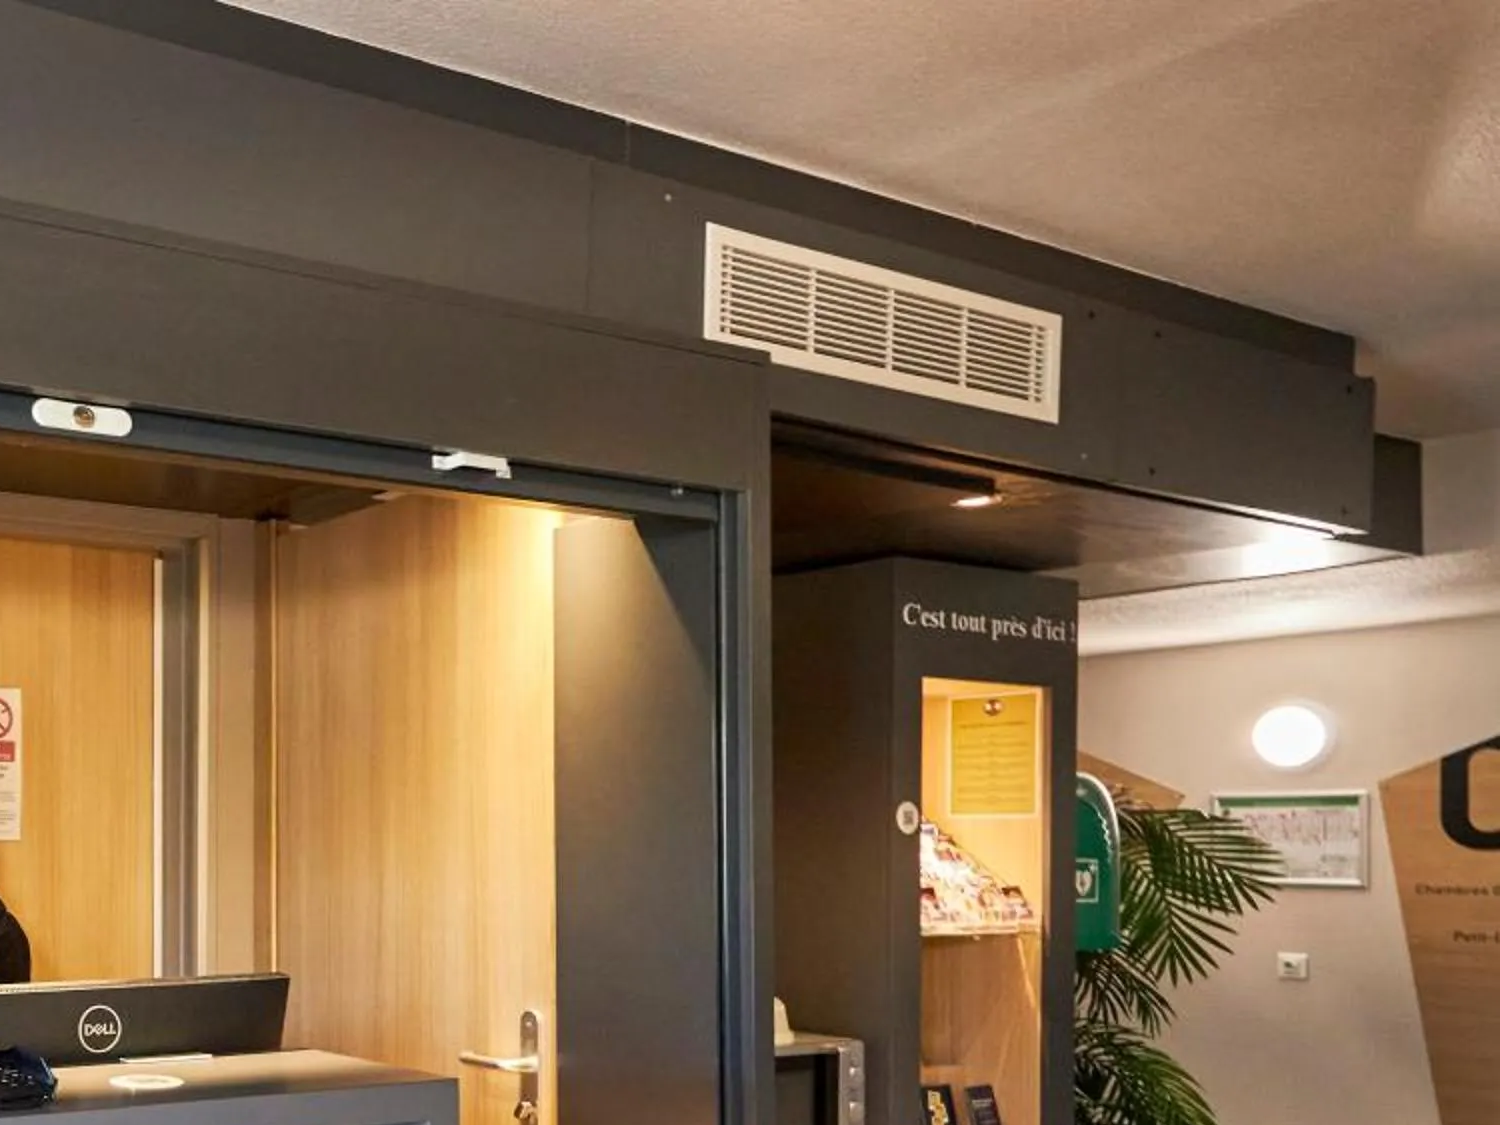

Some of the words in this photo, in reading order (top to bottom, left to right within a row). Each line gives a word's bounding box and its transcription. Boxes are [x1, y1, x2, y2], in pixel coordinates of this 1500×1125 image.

[902, 602, 946, 630] C'est
[951, 612, 987, 634] tout
[991, 615, 1028, 641] près
[1031, 616, 1066, 642] d'ici
[83, 1022, 117, 1037] DELL
